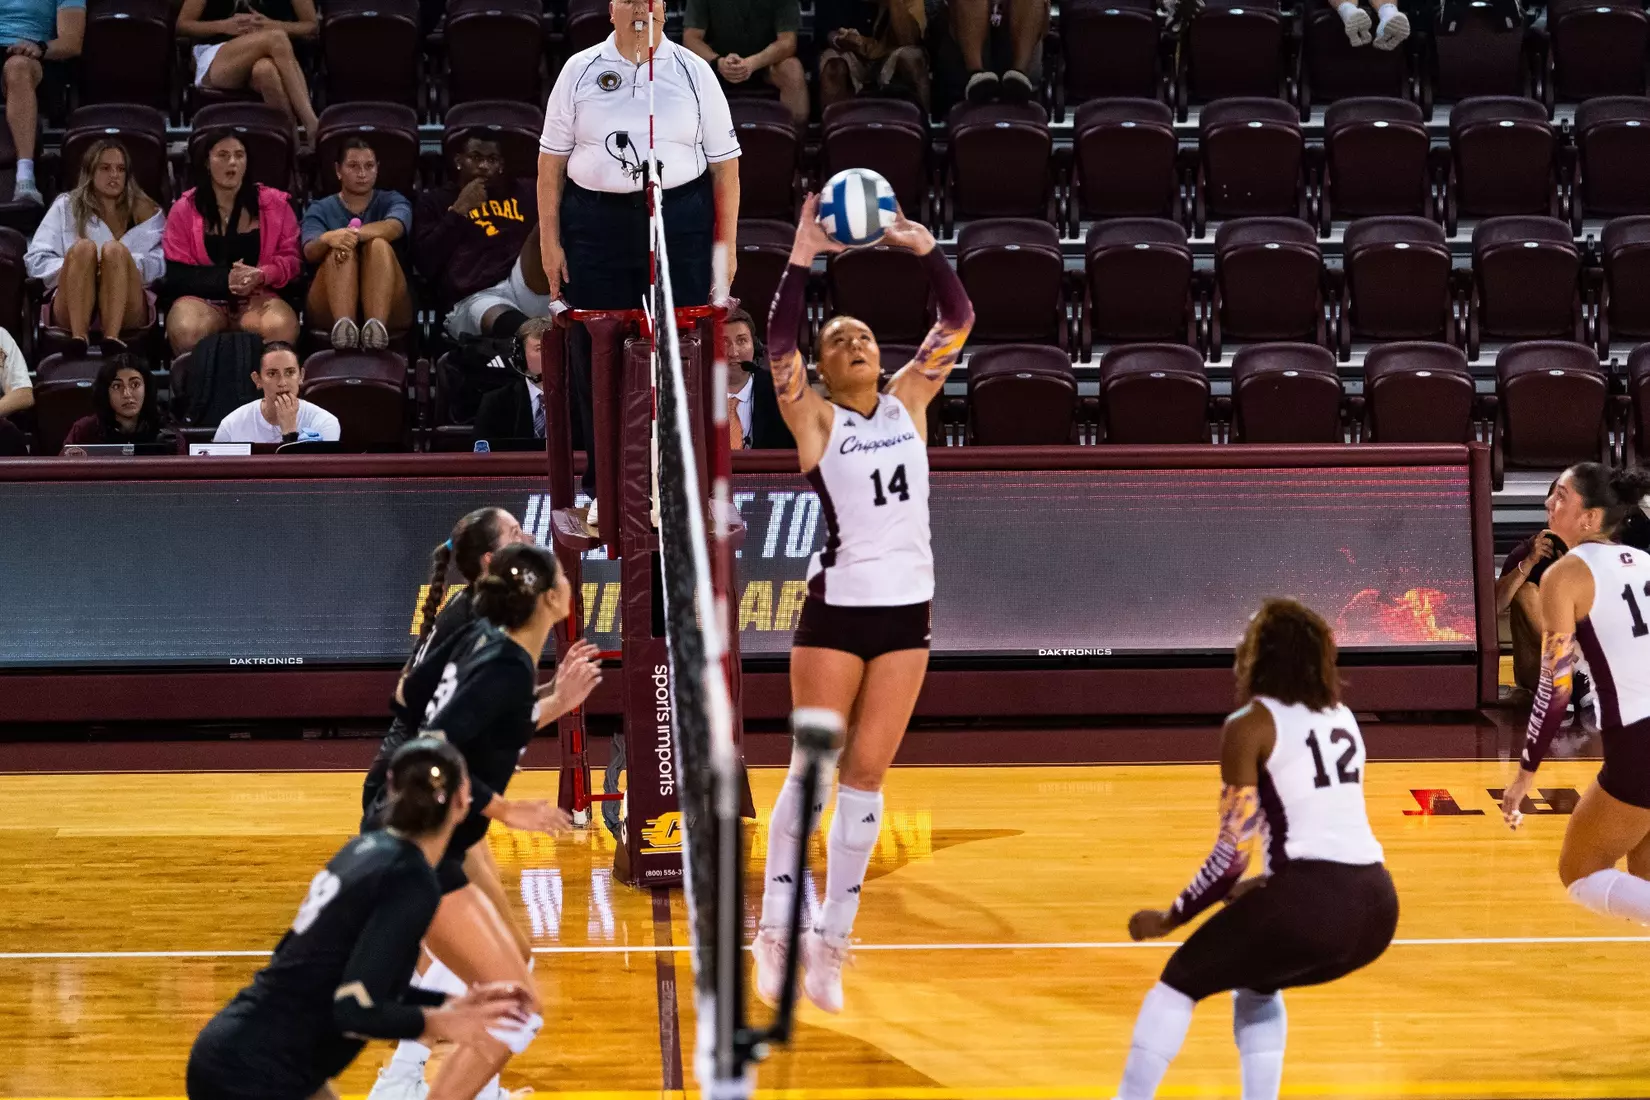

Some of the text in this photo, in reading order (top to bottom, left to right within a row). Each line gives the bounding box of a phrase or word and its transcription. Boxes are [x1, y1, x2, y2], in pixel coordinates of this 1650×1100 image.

[870, 464, 910, 507] 14
[762, 491, 822, 558] TO
[1621, 580, 1650, 638] 1
[229, 657, 304, 665] DAKTRONICS
[1038, 648, 1112, 656] DAKTRONICS
[651, 665, 675, 796] sports imports
[1305, 727, 1360, 789] 12
